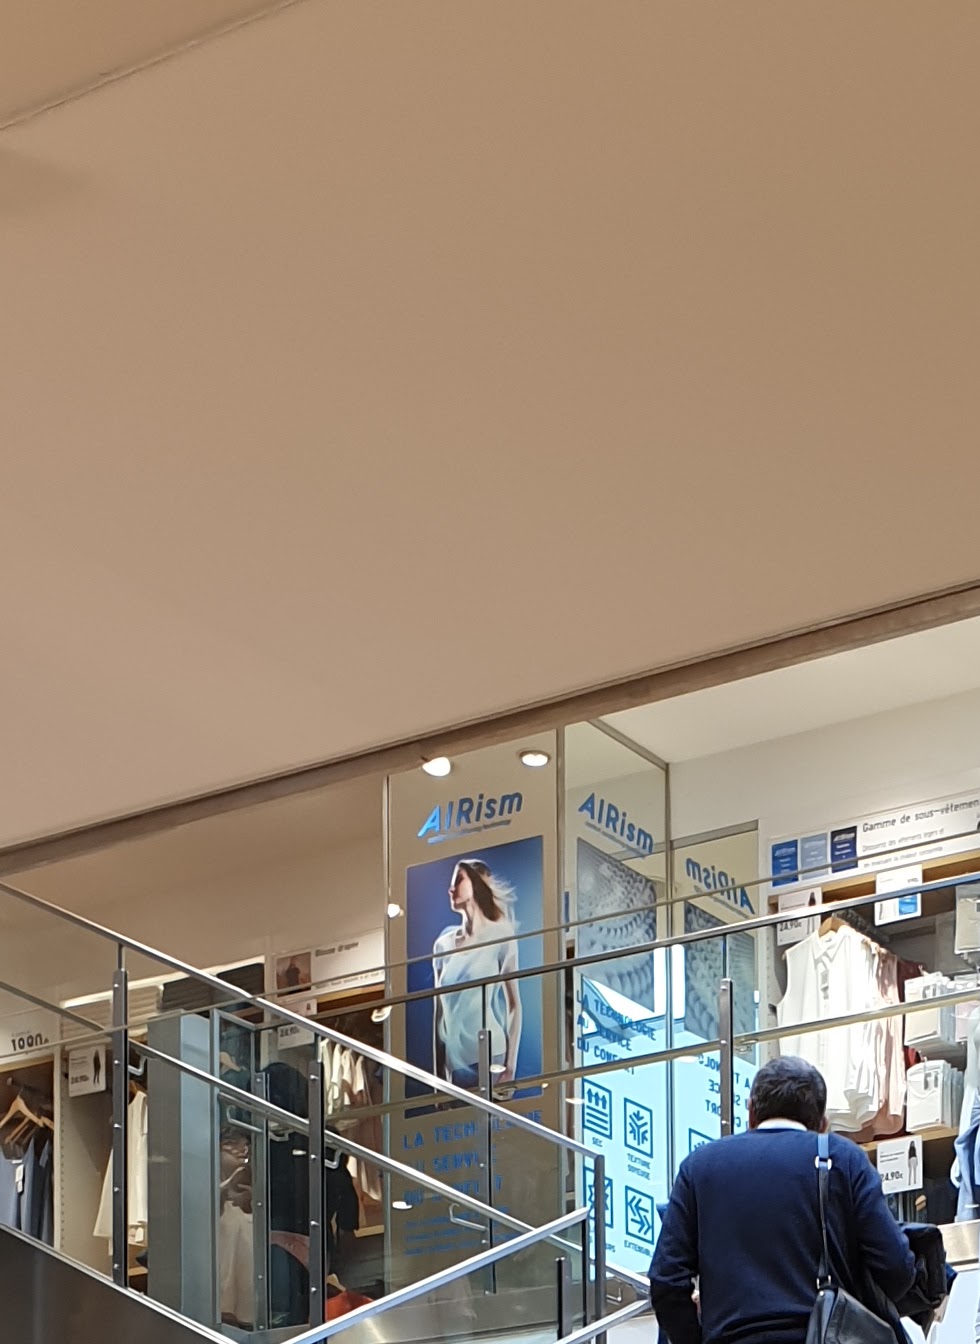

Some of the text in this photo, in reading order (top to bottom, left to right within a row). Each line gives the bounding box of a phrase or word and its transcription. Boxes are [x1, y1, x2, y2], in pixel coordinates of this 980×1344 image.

[417, 792, 523, 838] AIRism
[578, 792, 654, 855] AIRism
[862, 818, 897, 833] Gamme
[900, 814, 911, 824] de
